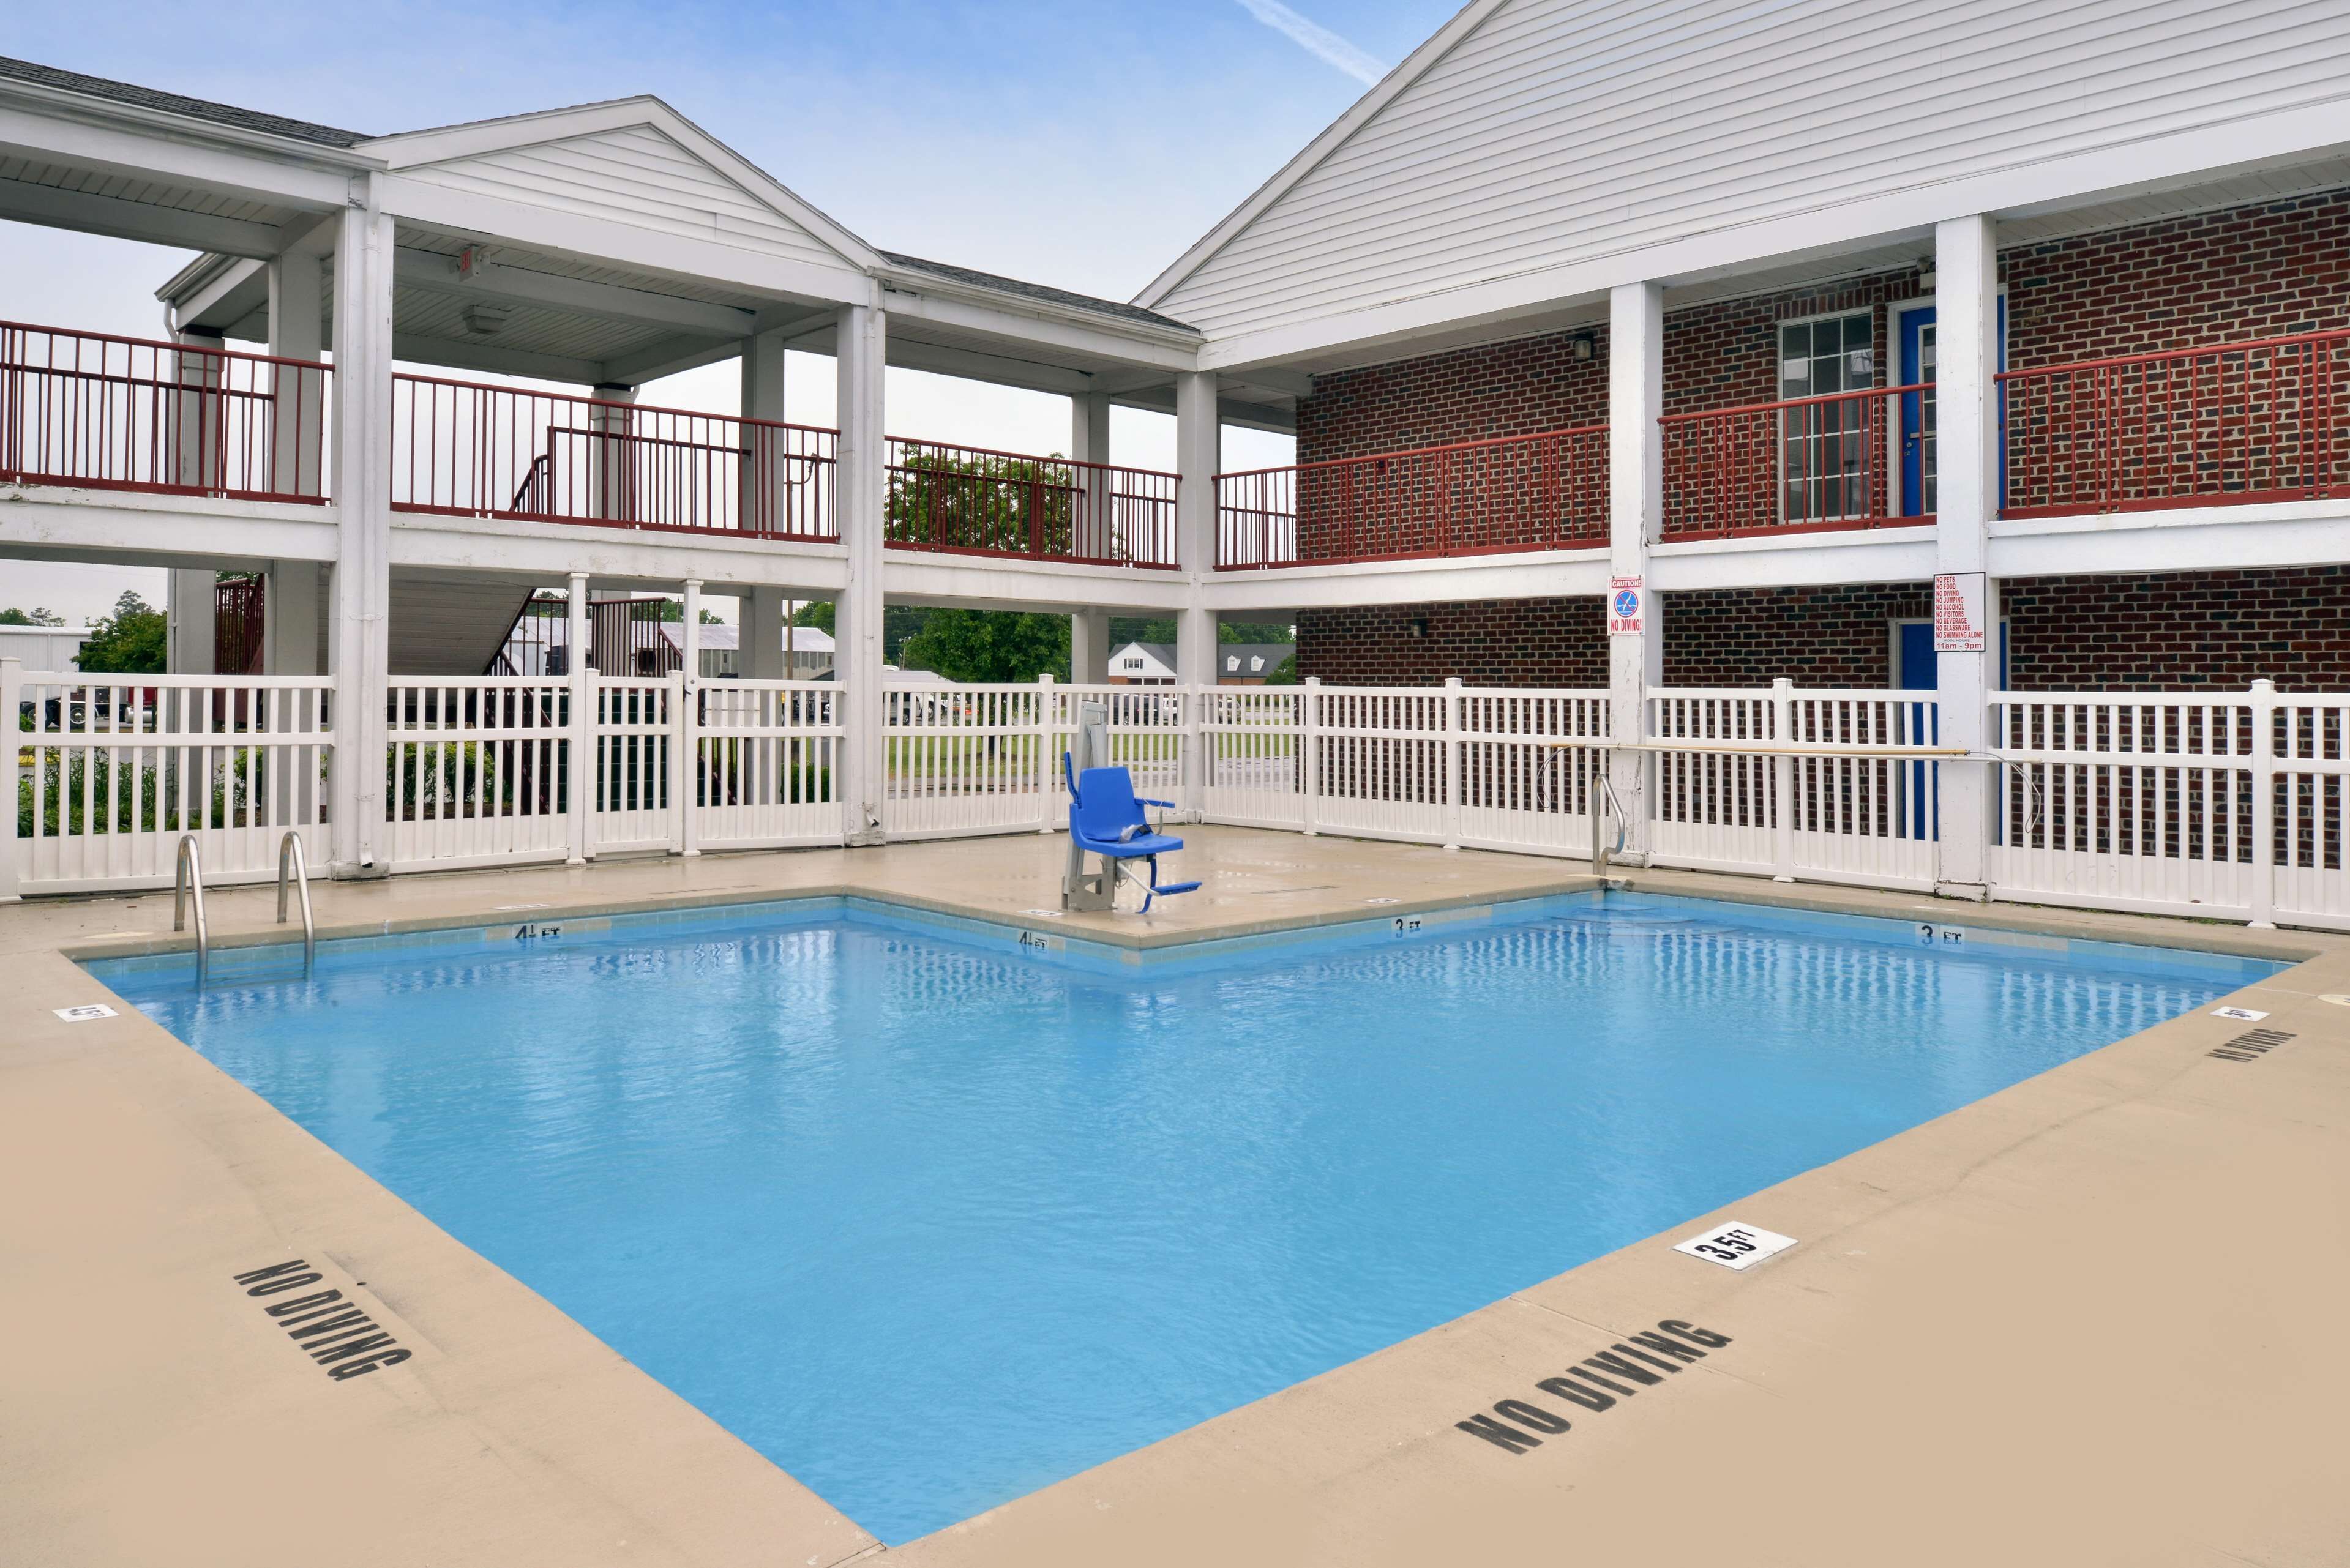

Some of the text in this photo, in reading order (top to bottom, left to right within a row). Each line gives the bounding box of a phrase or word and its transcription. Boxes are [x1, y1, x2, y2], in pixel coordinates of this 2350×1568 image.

[1611, 618, 1642, 632] NO DIVING!
[2204, 1028, 2297, 1063] NO DIVING
[233, 1258, 413, 1382] NO DIVING
[1454, 1319, 1734, 1455] NO DIVING
